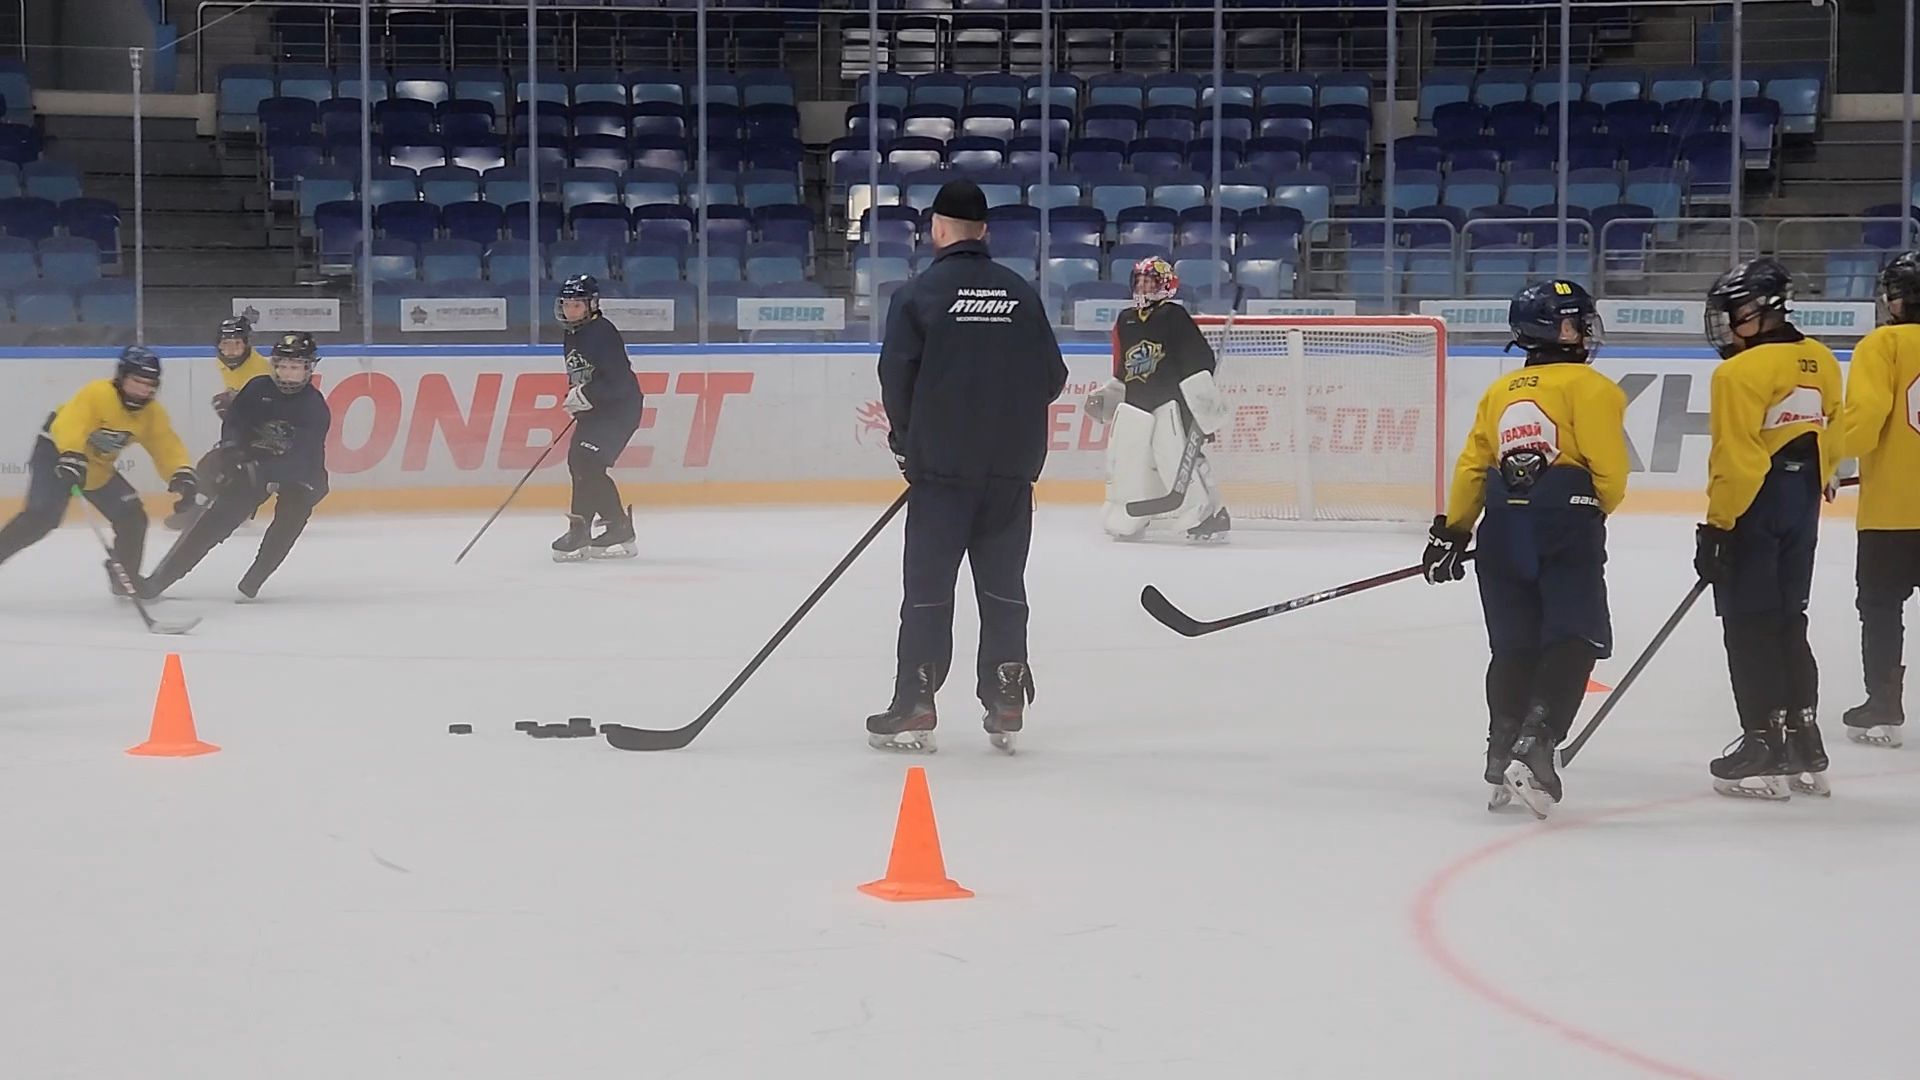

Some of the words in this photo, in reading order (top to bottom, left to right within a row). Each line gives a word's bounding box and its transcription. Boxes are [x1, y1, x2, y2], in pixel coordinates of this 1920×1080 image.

[957, 289, 1007, 297] АКАДЕМИЯ
[758, 306, 825, 322] SIBUR
[947, 299, 1019, 314] АТЛАНТ
[1616, 308, 1685, 325] SIBUR
[1508, 375, 1539, 391] 2013
[310, 372, 755, 474] ONBET
